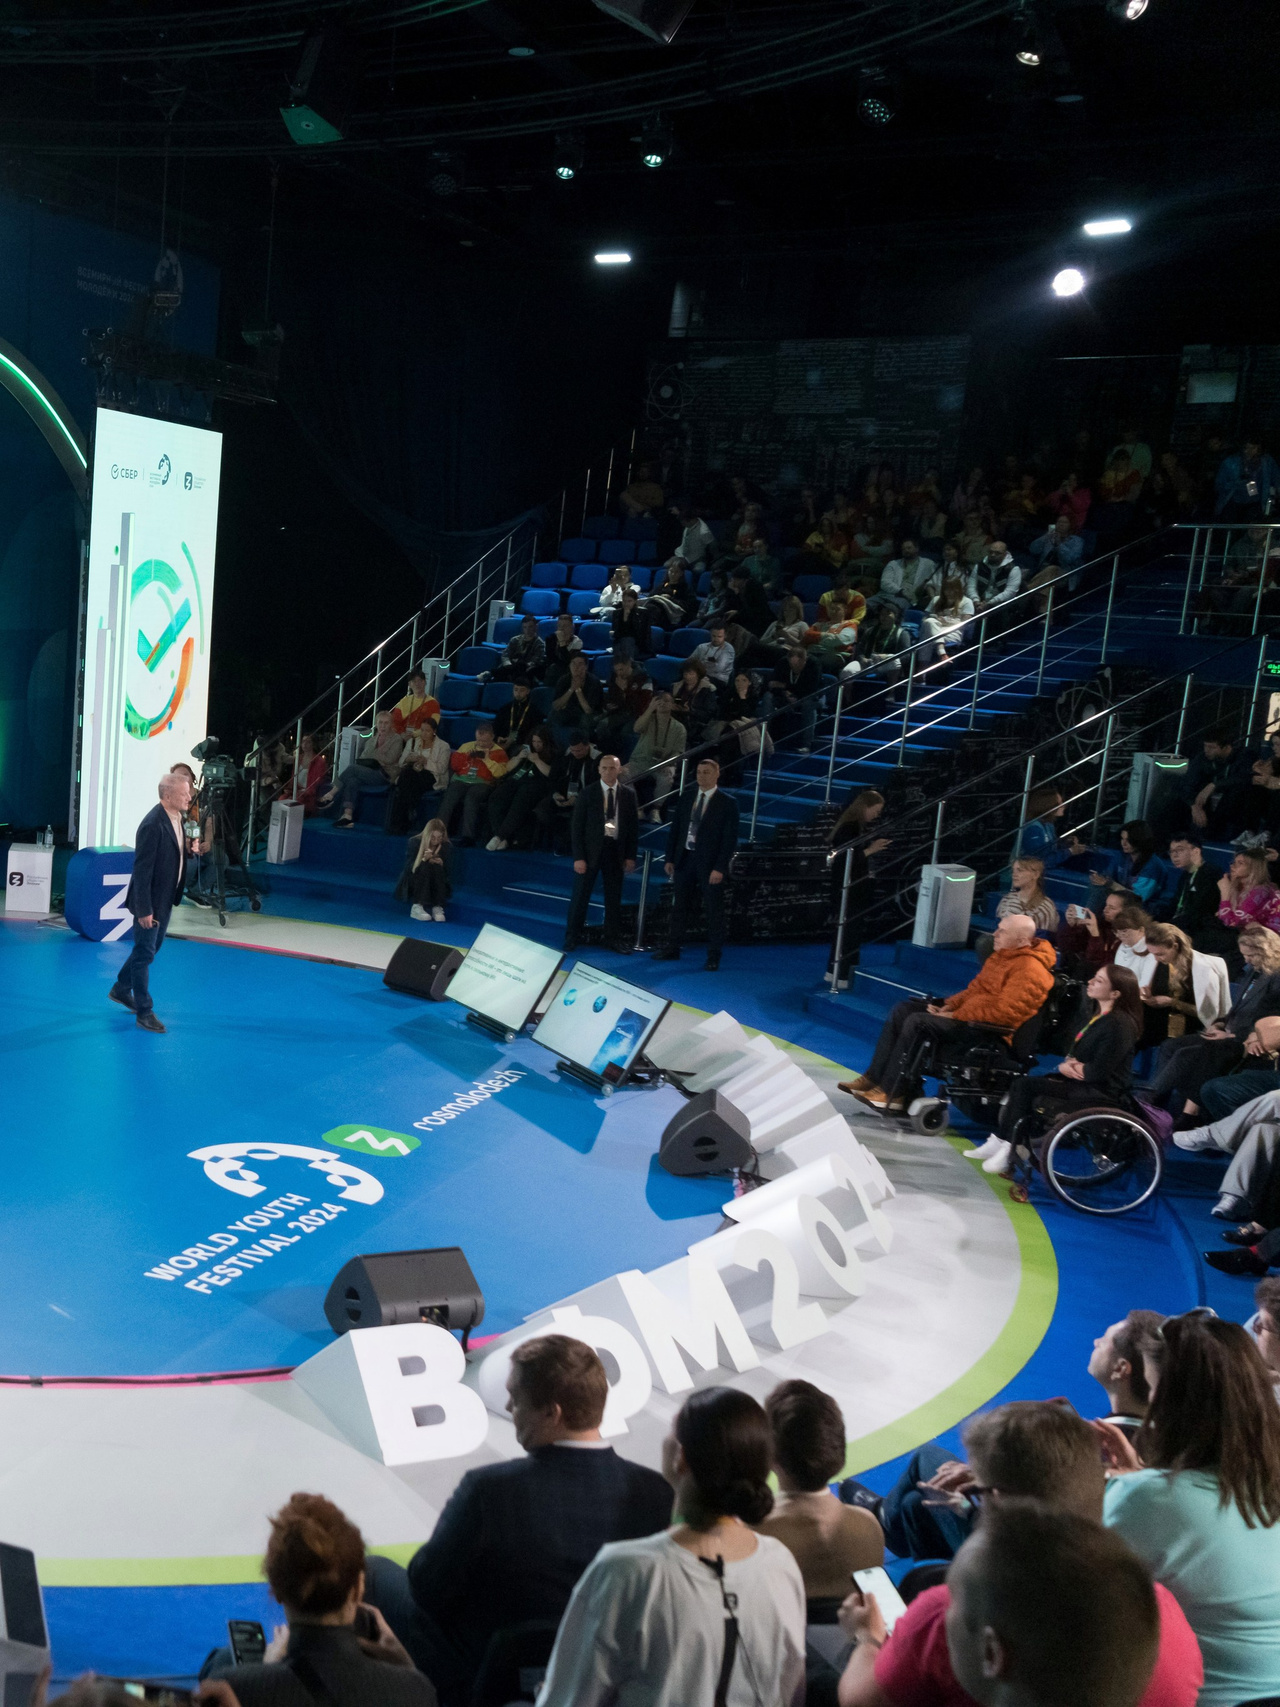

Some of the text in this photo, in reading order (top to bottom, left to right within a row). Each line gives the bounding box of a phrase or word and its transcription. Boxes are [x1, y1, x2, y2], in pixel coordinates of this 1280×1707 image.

[120, 468, 138, 480] СБЕР
[412, 1070, 528, 1132] rosmolodezh
[143, 1192, 311, 1281] WORLD YOUTH
[184, 1202, 348, 1295] FESTIVAL 2024
